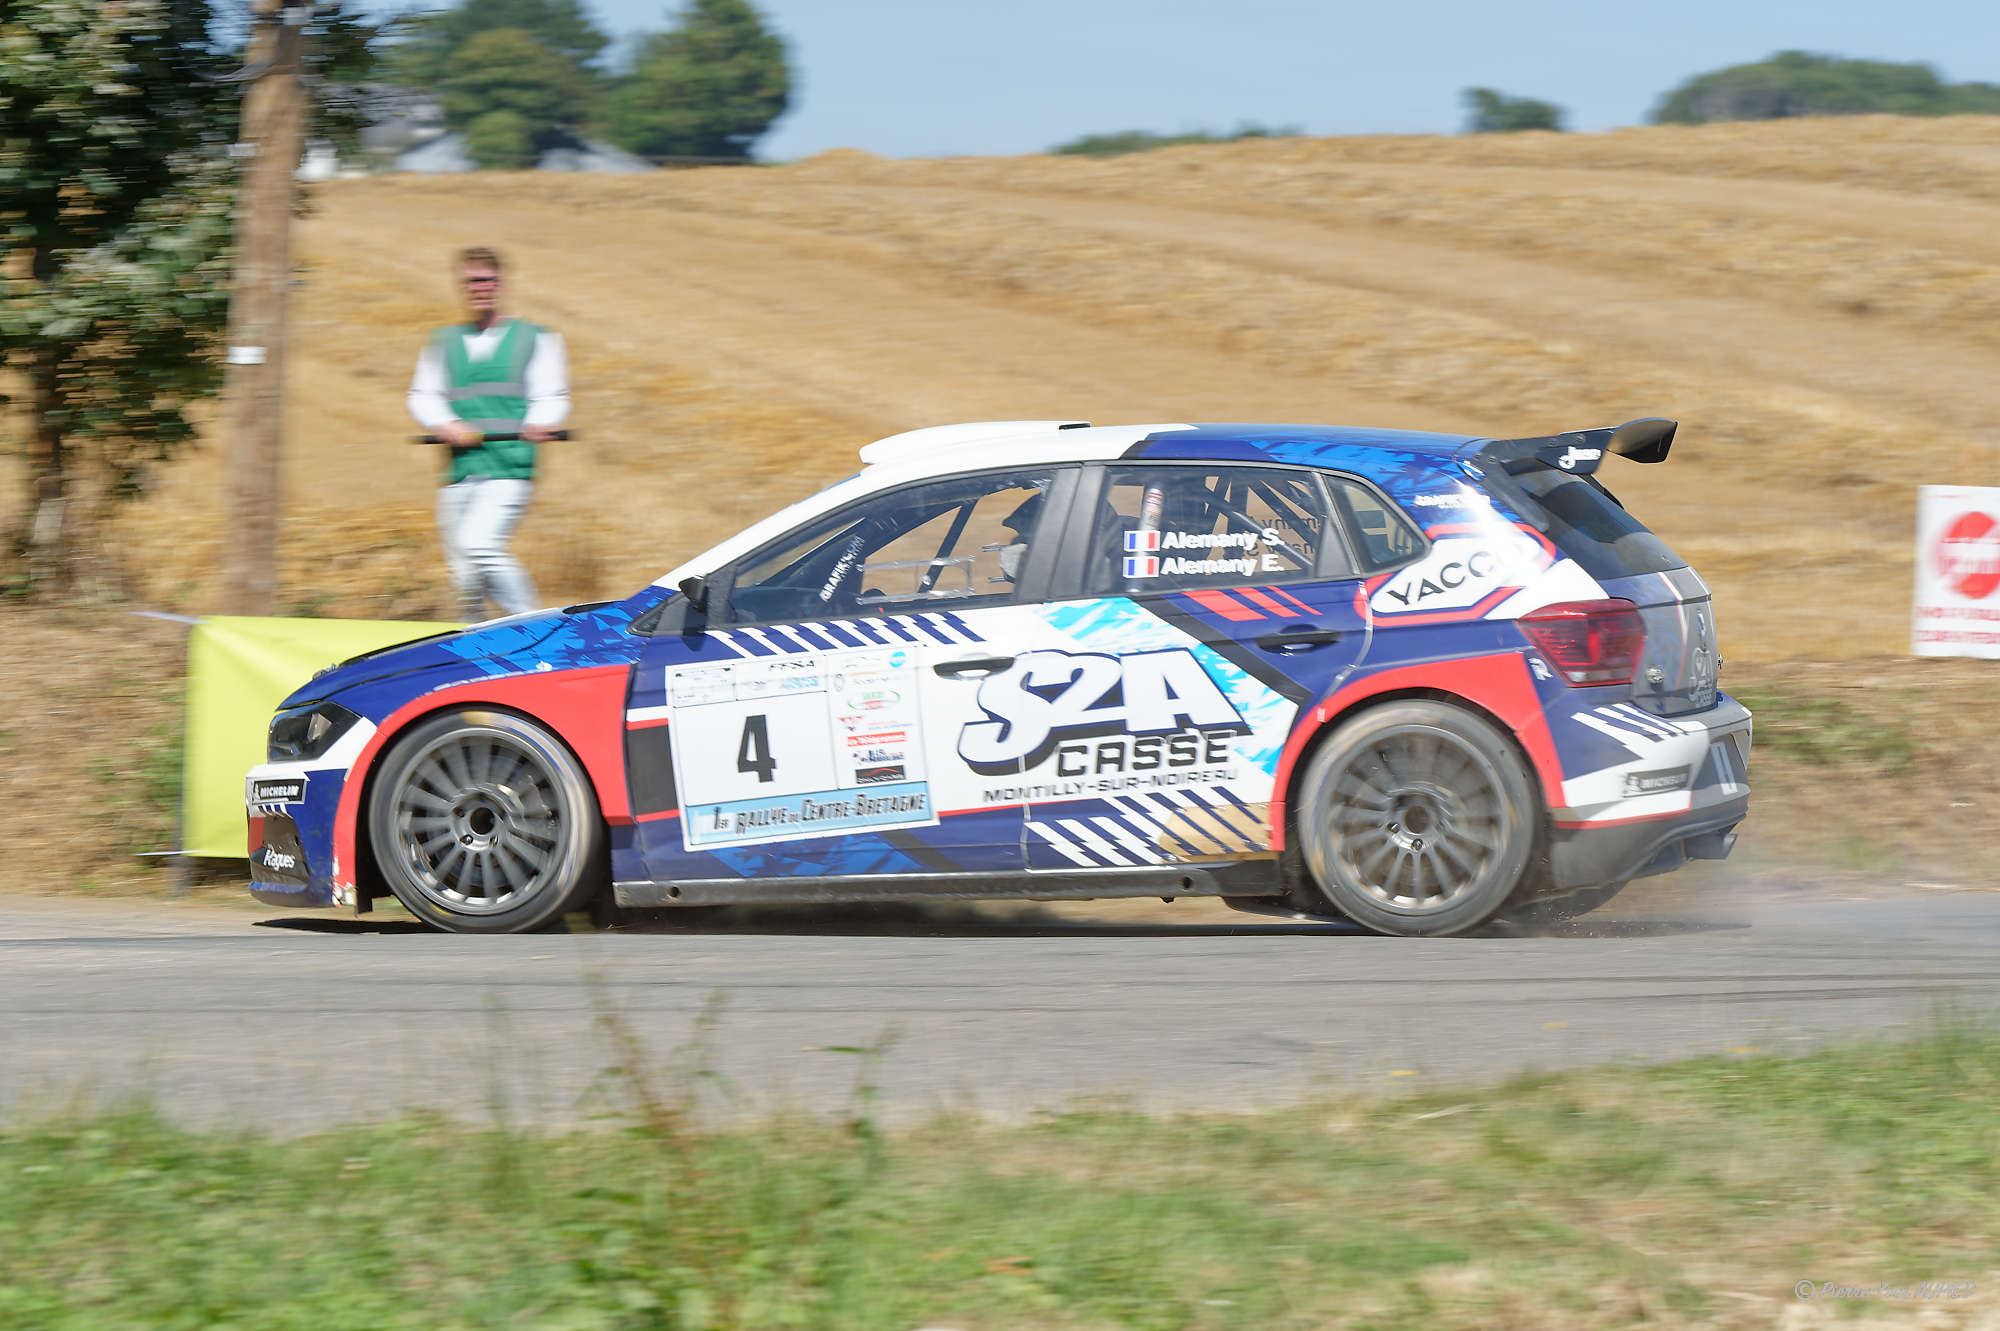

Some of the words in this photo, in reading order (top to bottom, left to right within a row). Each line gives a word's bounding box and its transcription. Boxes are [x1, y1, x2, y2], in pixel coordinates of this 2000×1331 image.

[1161, 531, 1258, 550] Alemany
[1262, 527, 1285, 546] S.
[1160, 557, 1257, 577] Alemany
[1261, 554, 1285, 572] E.
[1386, 546, 1512, 606] YACC
[957, 648, 1250, 776] S2A
[738, 714, 776, 783] 4
[1057, 729, 1237, 777] CASSE
[260, 785, 299, 798] MICHELIN
[983, 768, 1239, 803] MONTILLY-SUR-NOIREAU
